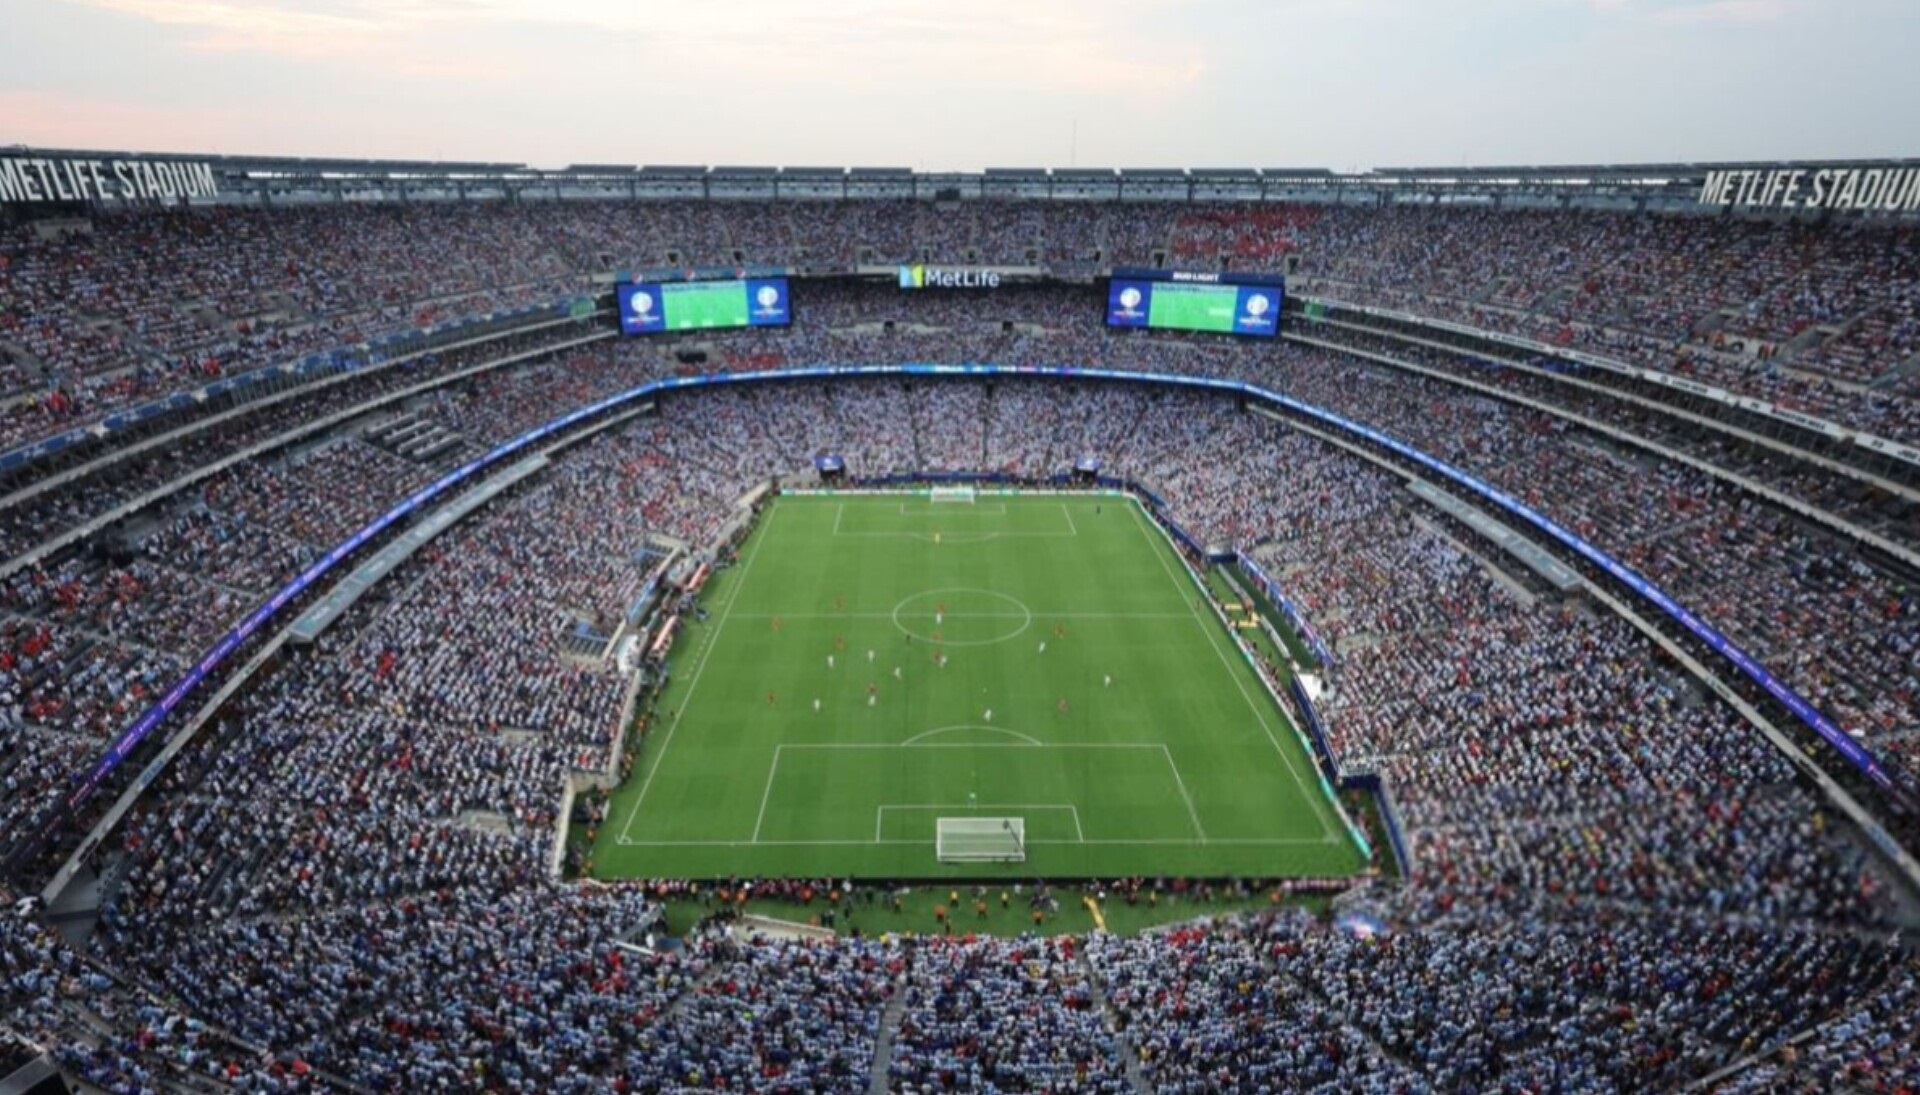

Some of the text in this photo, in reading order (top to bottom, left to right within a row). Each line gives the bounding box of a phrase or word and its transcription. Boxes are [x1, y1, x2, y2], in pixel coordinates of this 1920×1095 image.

[0, 158, 218, 201] METLIFE STADIUM
[1699, 169, 1807, 207] METLIFE
[925, 268, 1000, 287] MetLife
[1193, 272, 1219, 282] LIGHT
